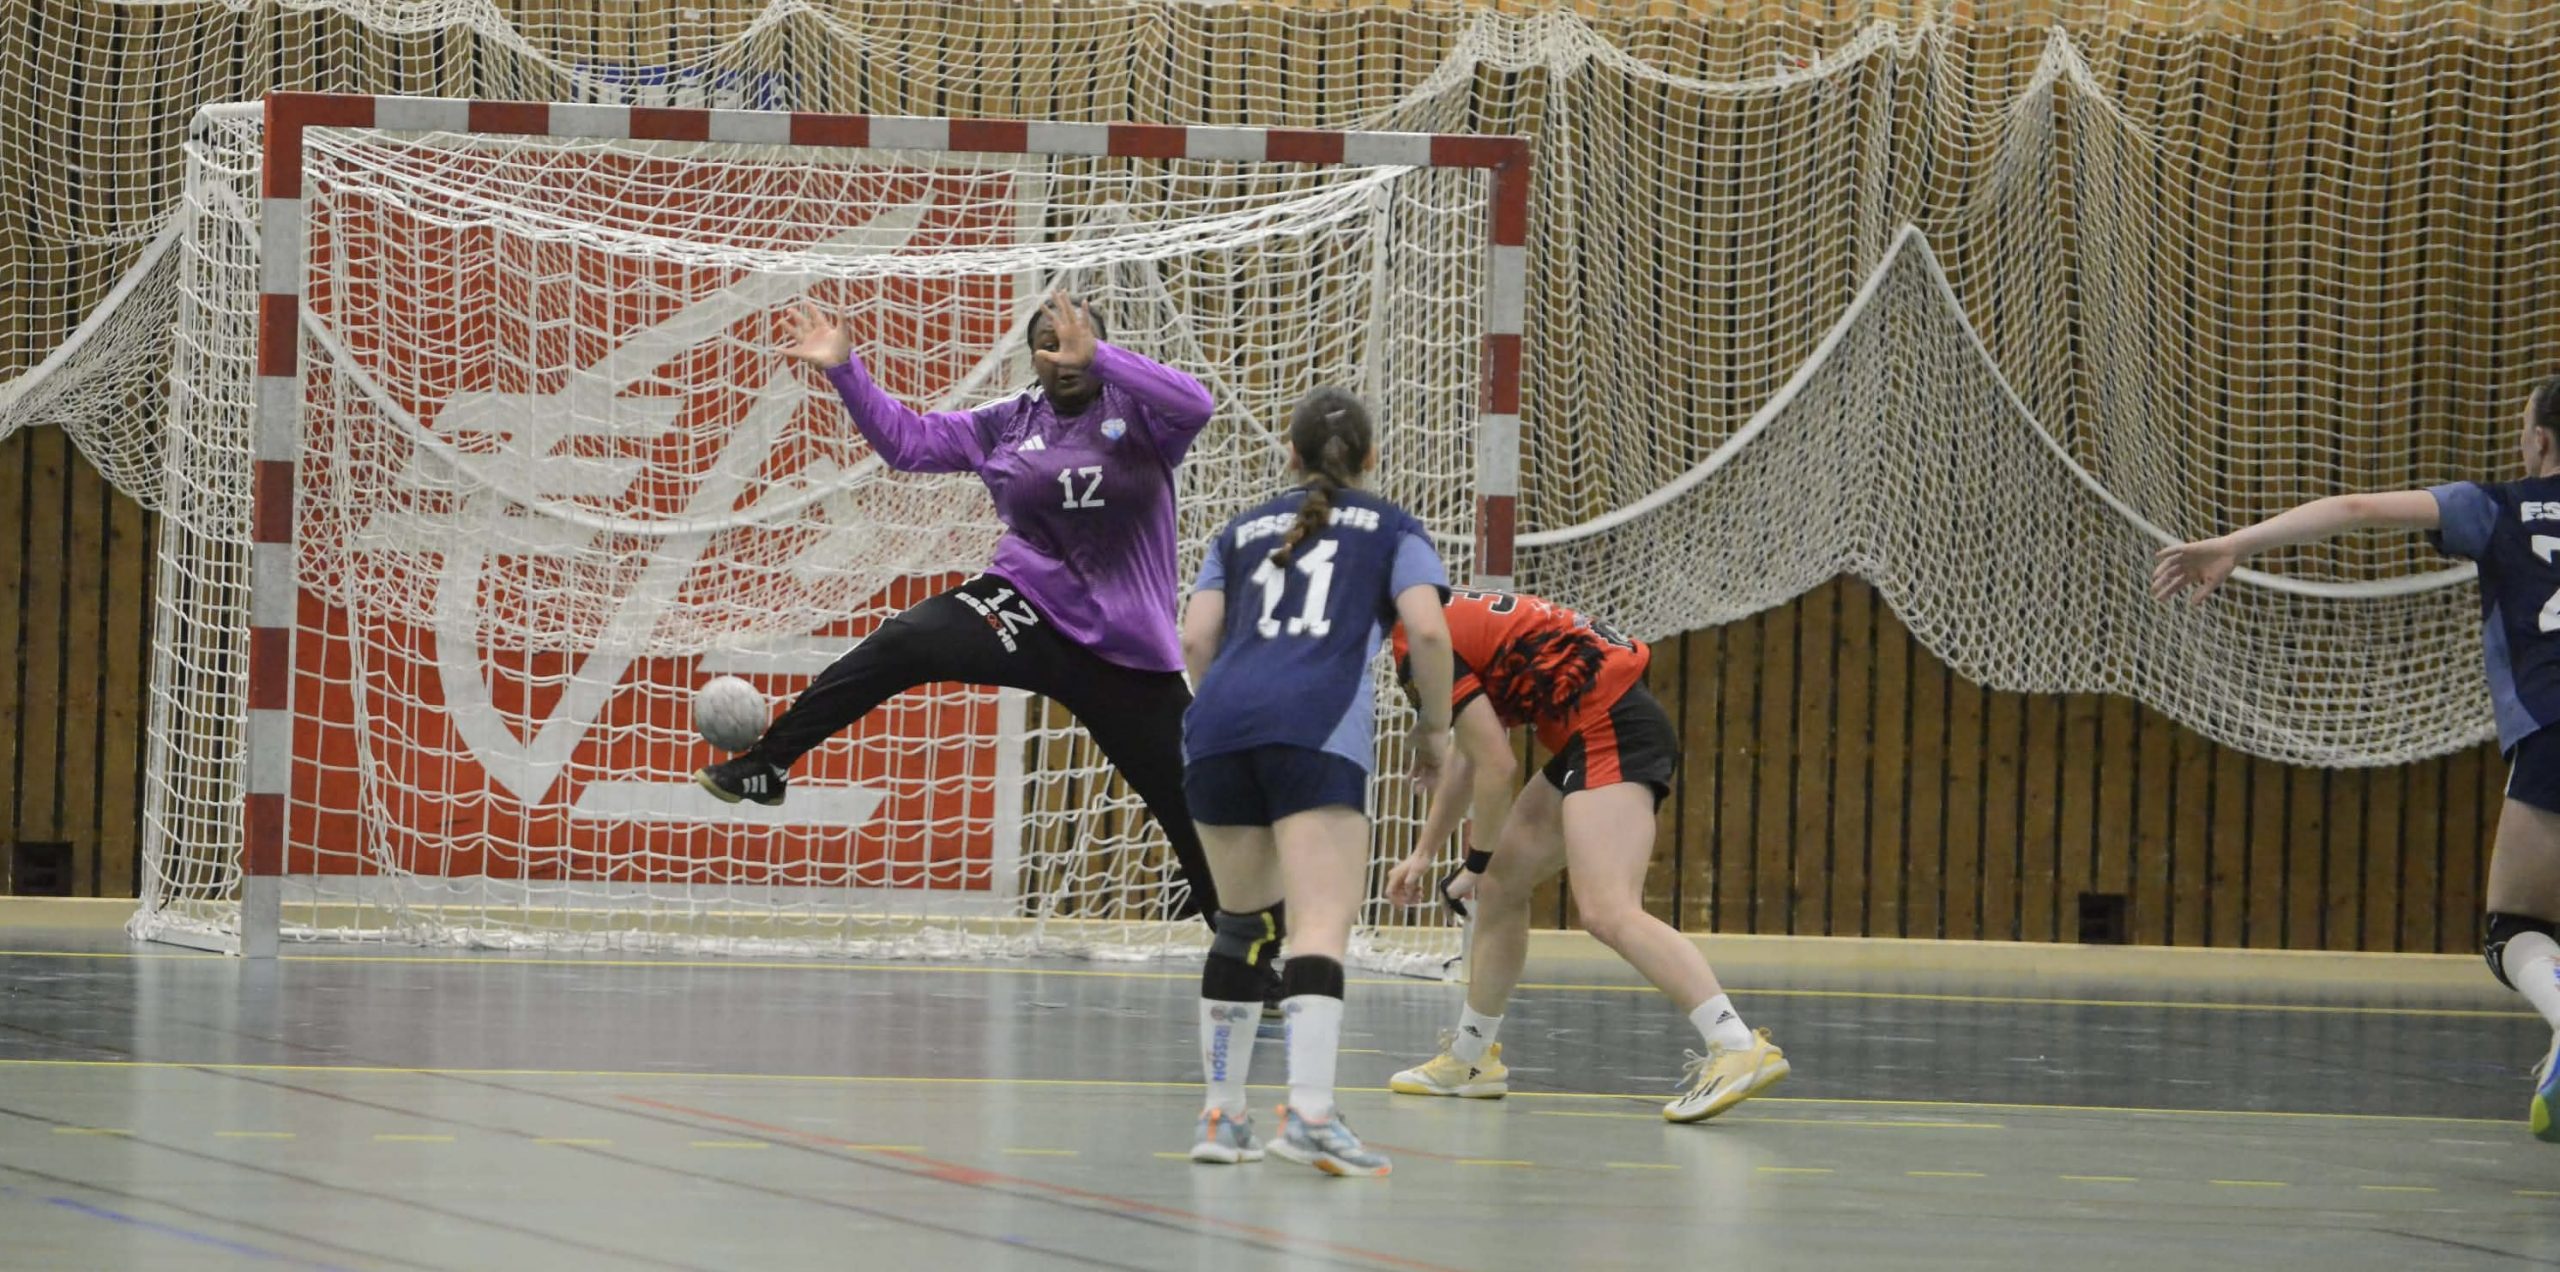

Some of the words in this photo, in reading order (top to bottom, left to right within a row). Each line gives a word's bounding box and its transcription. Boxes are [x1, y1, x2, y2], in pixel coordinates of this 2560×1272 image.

[1057, 465, 1105, 509] 12
[984, 587, 1039, 635] 12
[1251, 539, 1339, 638] 11
